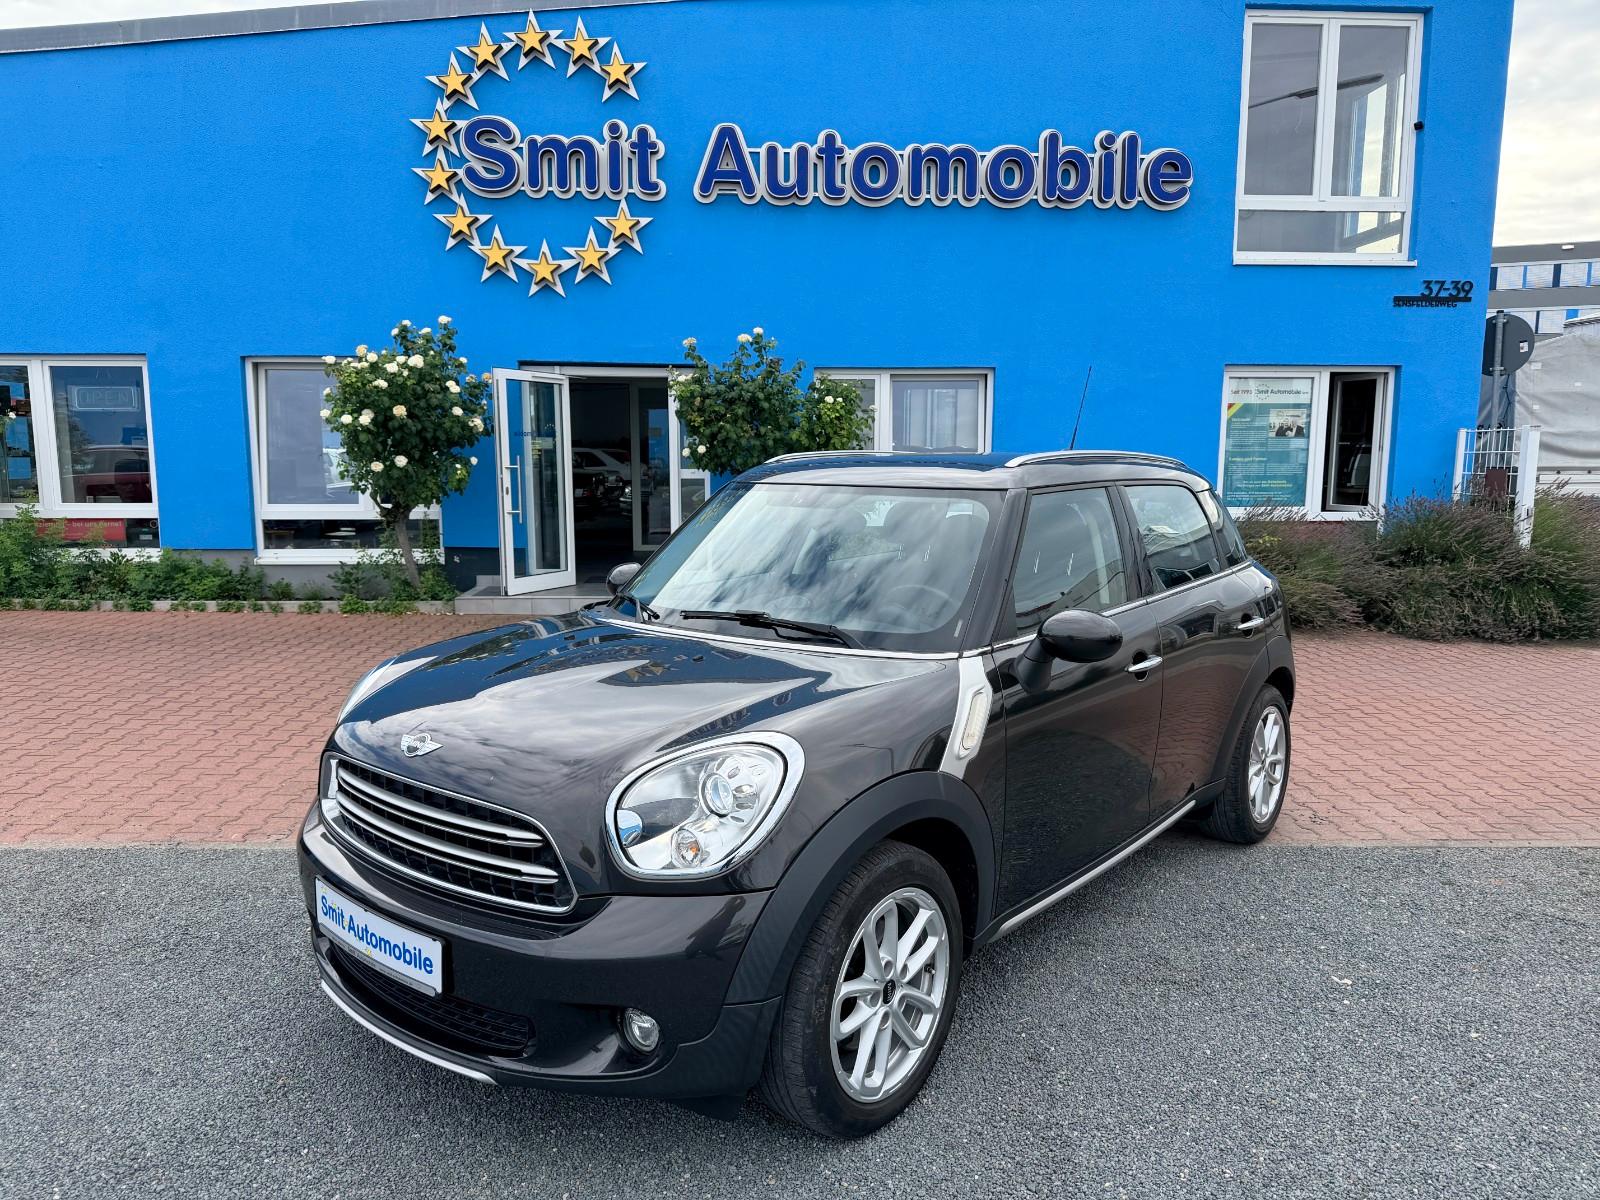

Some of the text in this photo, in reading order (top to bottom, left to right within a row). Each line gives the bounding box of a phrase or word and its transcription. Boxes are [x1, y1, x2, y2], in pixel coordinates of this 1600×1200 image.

[460, 116, 1193, 207] Smit Automobile
[1420, 280, 1474, 298] 37-39
[321, 895, 345, 930] Smit
[348, 914, 433, 975] Automobile
